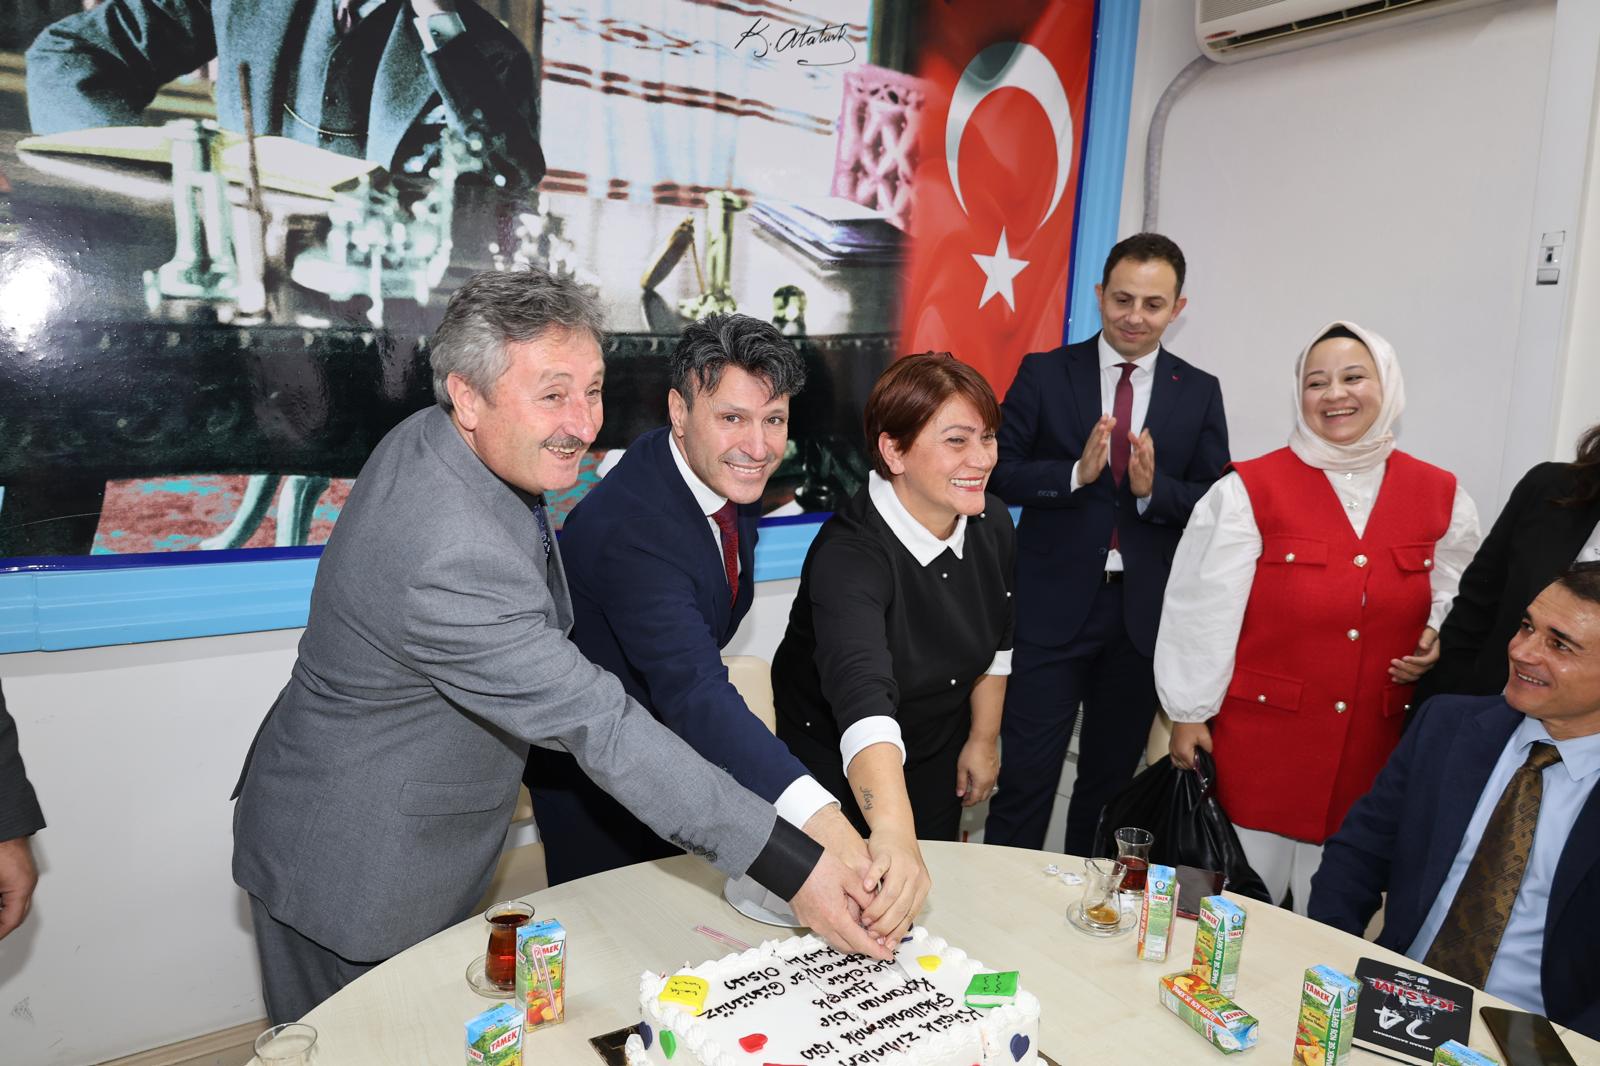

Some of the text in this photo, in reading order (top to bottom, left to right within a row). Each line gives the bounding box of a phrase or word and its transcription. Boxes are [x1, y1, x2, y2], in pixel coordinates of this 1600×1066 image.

[724, 966, 780, 990] Olsun
[696, 981, 786, 1019] Gününüz
[1305, 982, 1330, 1003] TAMEK
[1374, 978, 1455, 1013] KASIM
[820, 1010, 855, 1027] bir
[1373, 1006, 1432, 1040] 24
[491, 1030, 518, 1052] TAMEK
[800, 1041, 840, 1060] için
